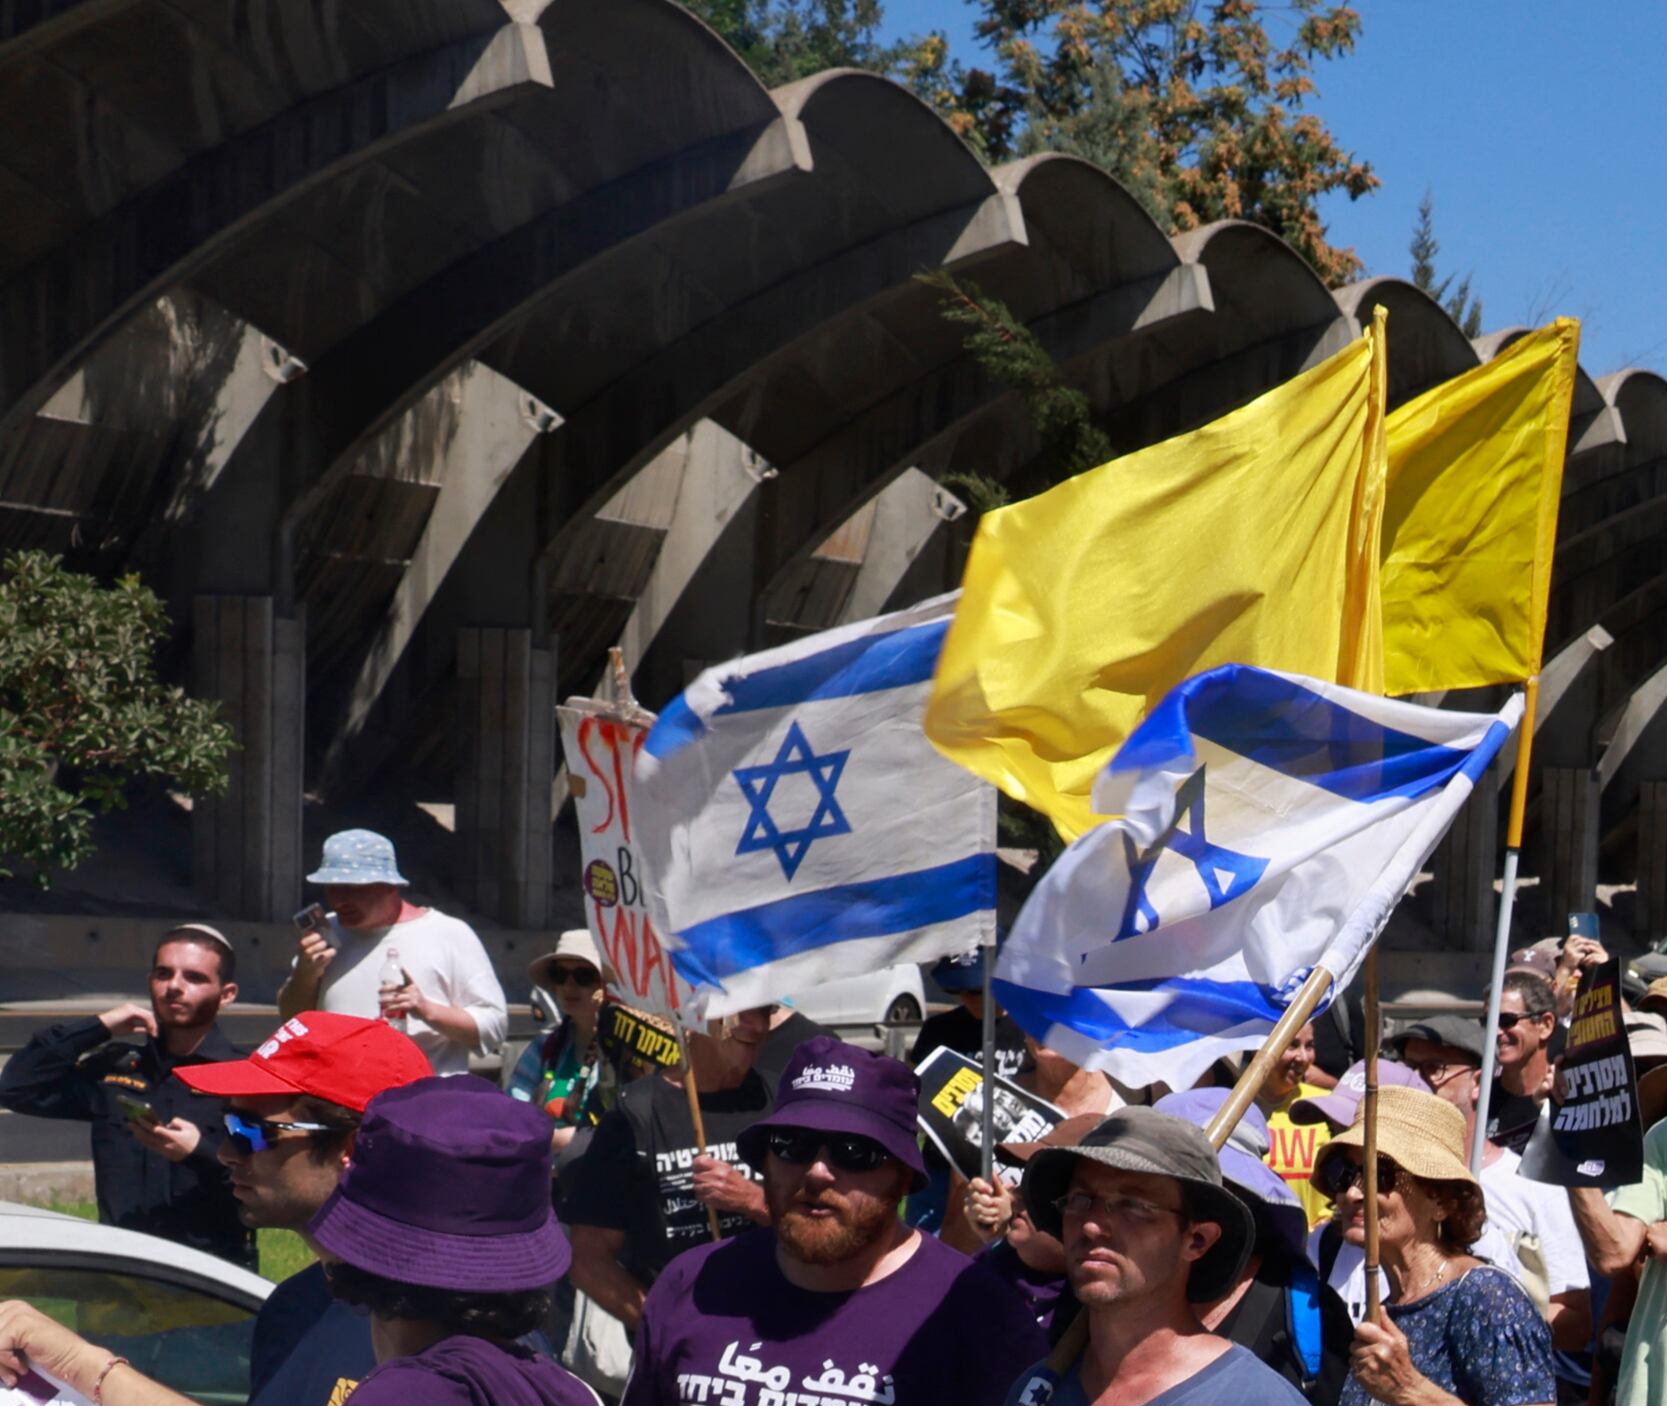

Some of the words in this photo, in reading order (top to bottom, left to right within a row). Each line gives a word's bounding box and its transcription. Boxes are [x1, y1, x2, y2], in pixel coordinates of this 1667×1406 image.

[613, 1011, 634, 1043] דוד
[636, 1022, 682, 1066] אביתר
[1562, 1054, 1628, 1099] מסרבים
[1553, 1090, 1632, 1132] למלחמה
[802, 1358, 896, 1406] نقف
